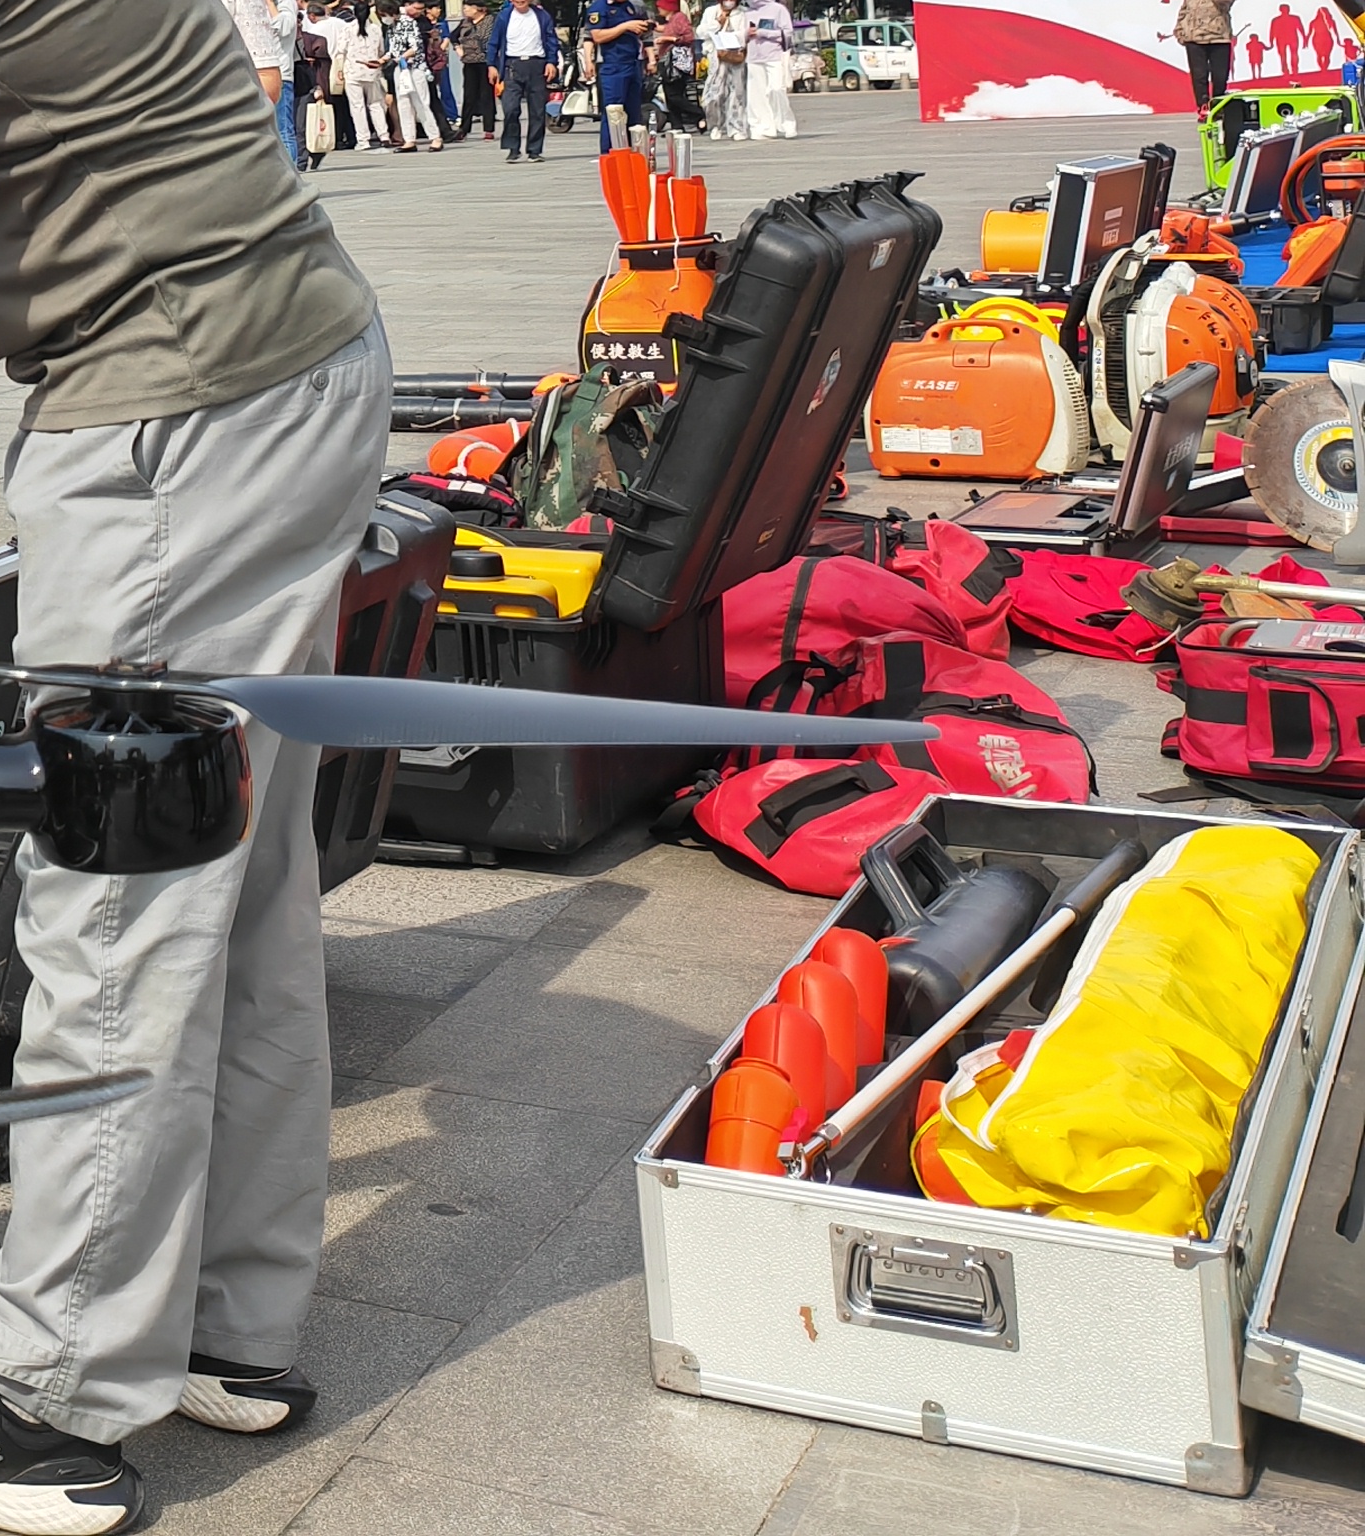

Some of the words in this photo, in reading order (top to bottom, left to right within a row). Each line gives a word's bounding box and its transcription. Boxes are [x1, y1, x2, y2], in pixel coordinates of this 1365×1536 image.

[589, 341, 665, 361] 便捷救生
[912, 379, 957, 391] KASE
